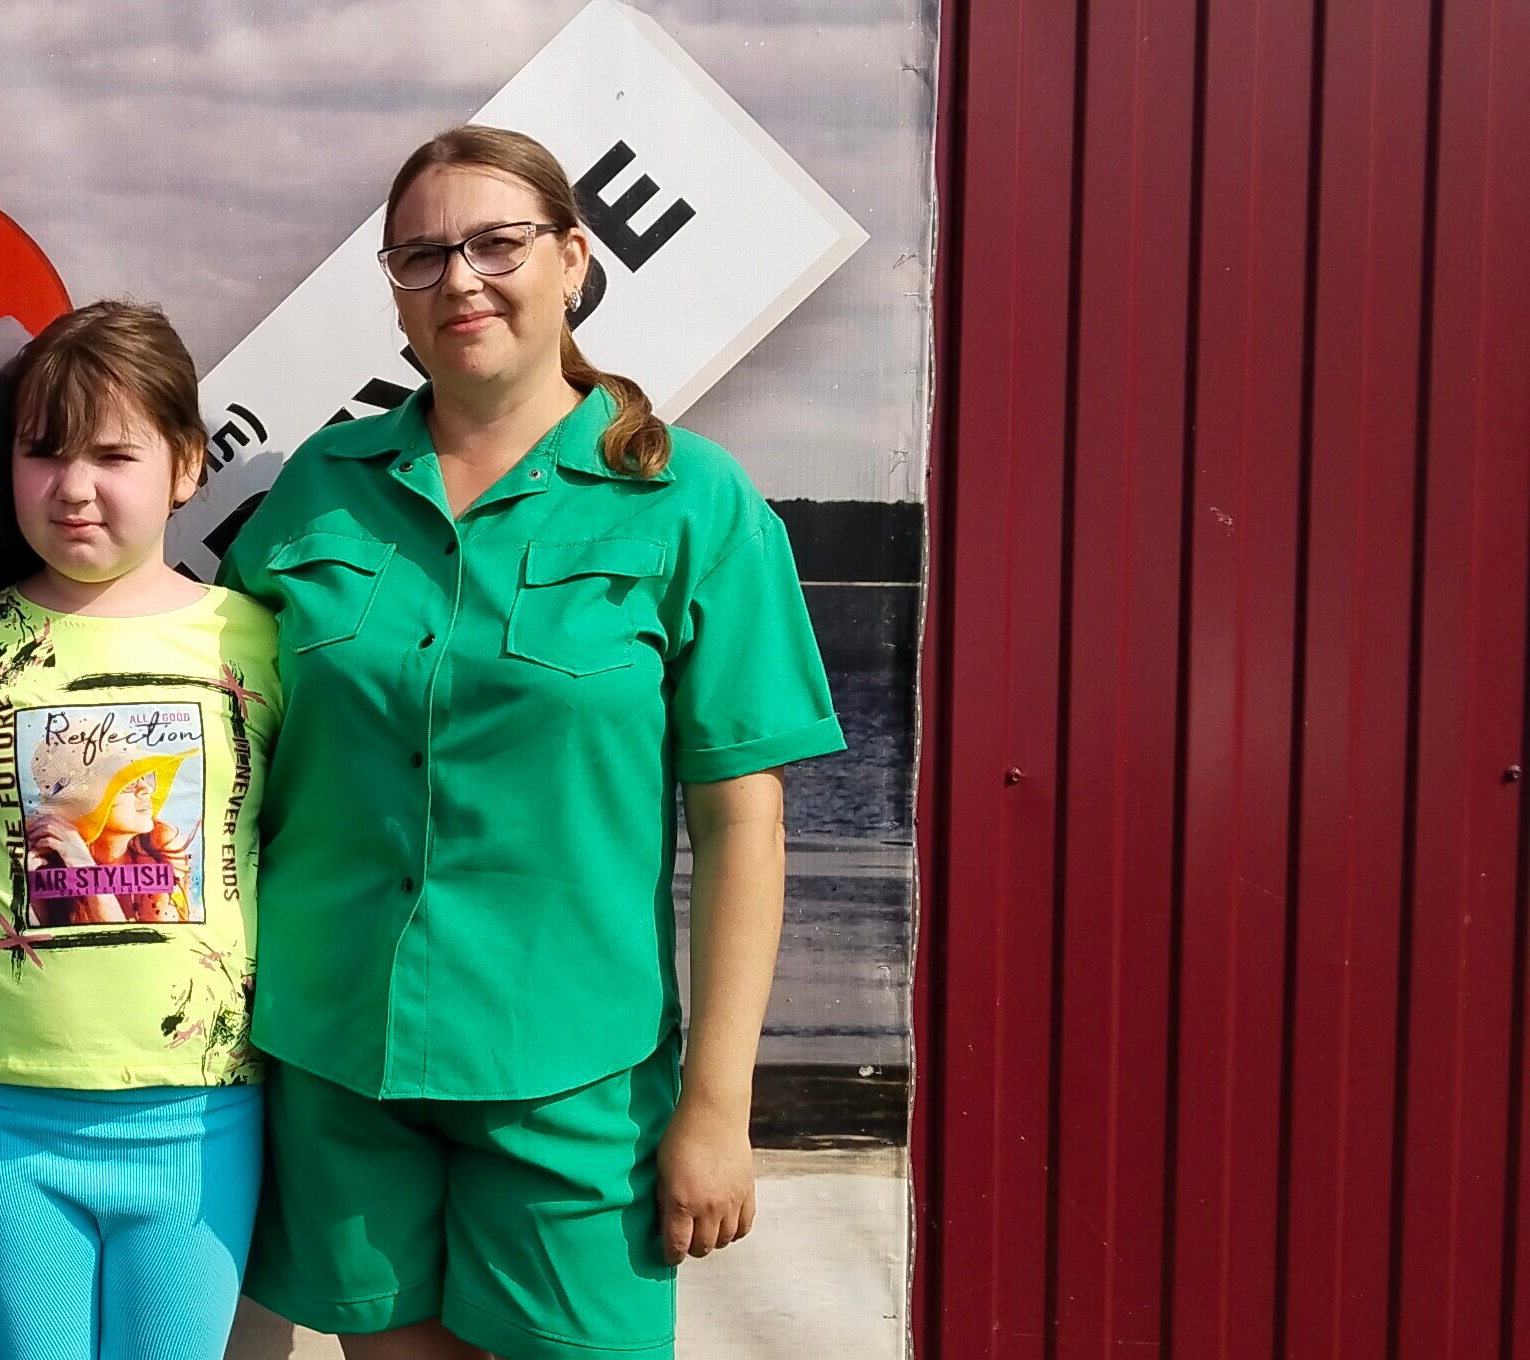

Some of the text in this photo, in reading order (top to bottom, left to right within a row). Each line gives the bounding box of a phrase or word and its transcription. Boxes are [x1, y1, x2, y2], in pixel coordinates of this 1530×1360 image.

[45, 711, 202, 766] Reflection
[162, 712, 191, 723] GOOD
[221, 765, 252, 836] NEVER
[4, 819, 26, 880] THE
[76, 865, 169, 889] STYLISH
[221, 844, 240, 902] ENDS
